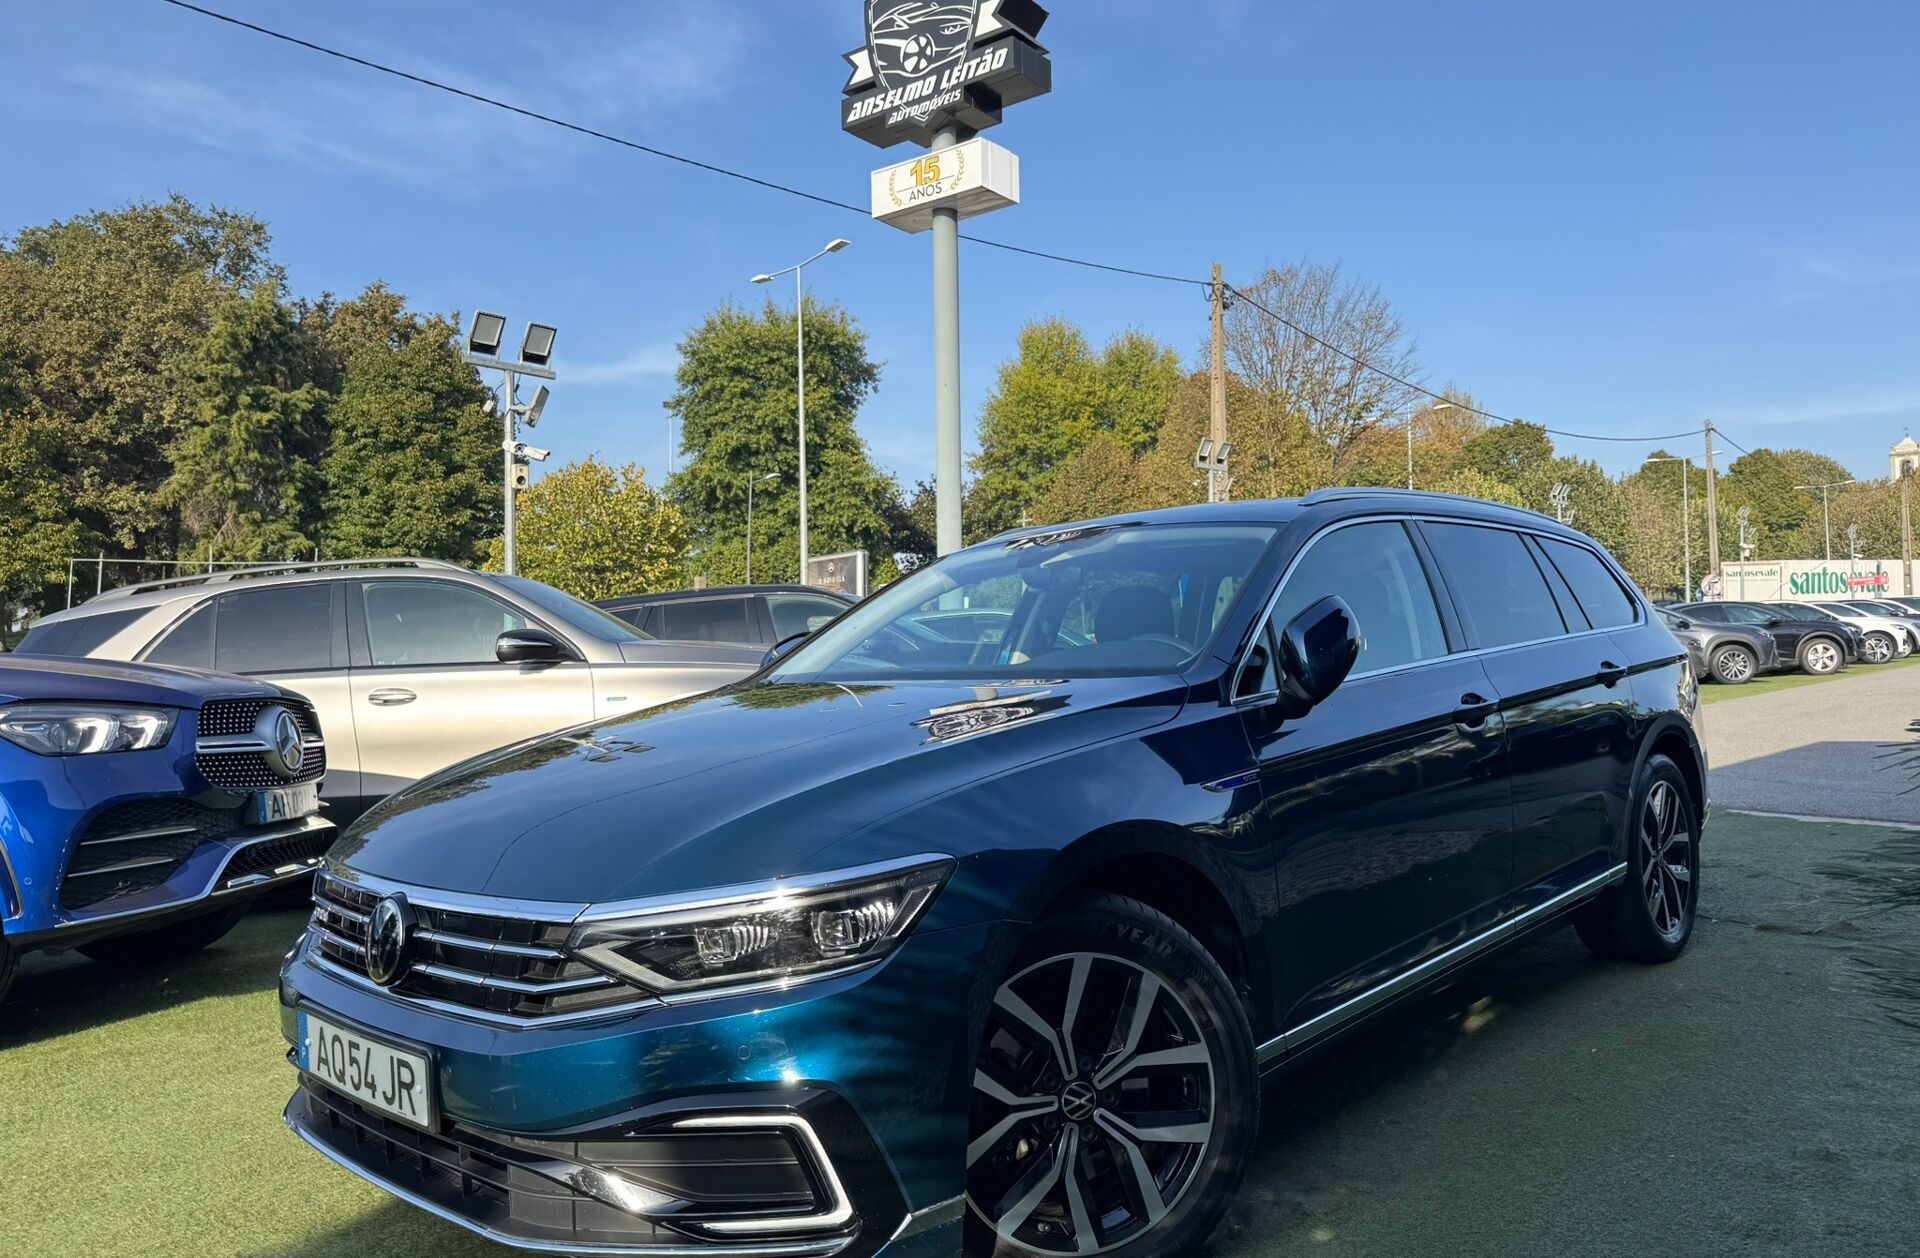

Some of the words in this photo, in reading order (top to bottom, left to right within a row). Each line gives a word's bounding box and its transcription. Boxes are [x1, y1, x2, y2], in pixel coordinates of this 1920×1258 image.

[847, 75, 937, 123] ANSELMO
[940, 47, 1008, 91] LEITÃO
[910, 156, 941, 187] 15
[909, 182, 942, 202] ANOS
[1726, 568, 1779, 577] sanosevale
